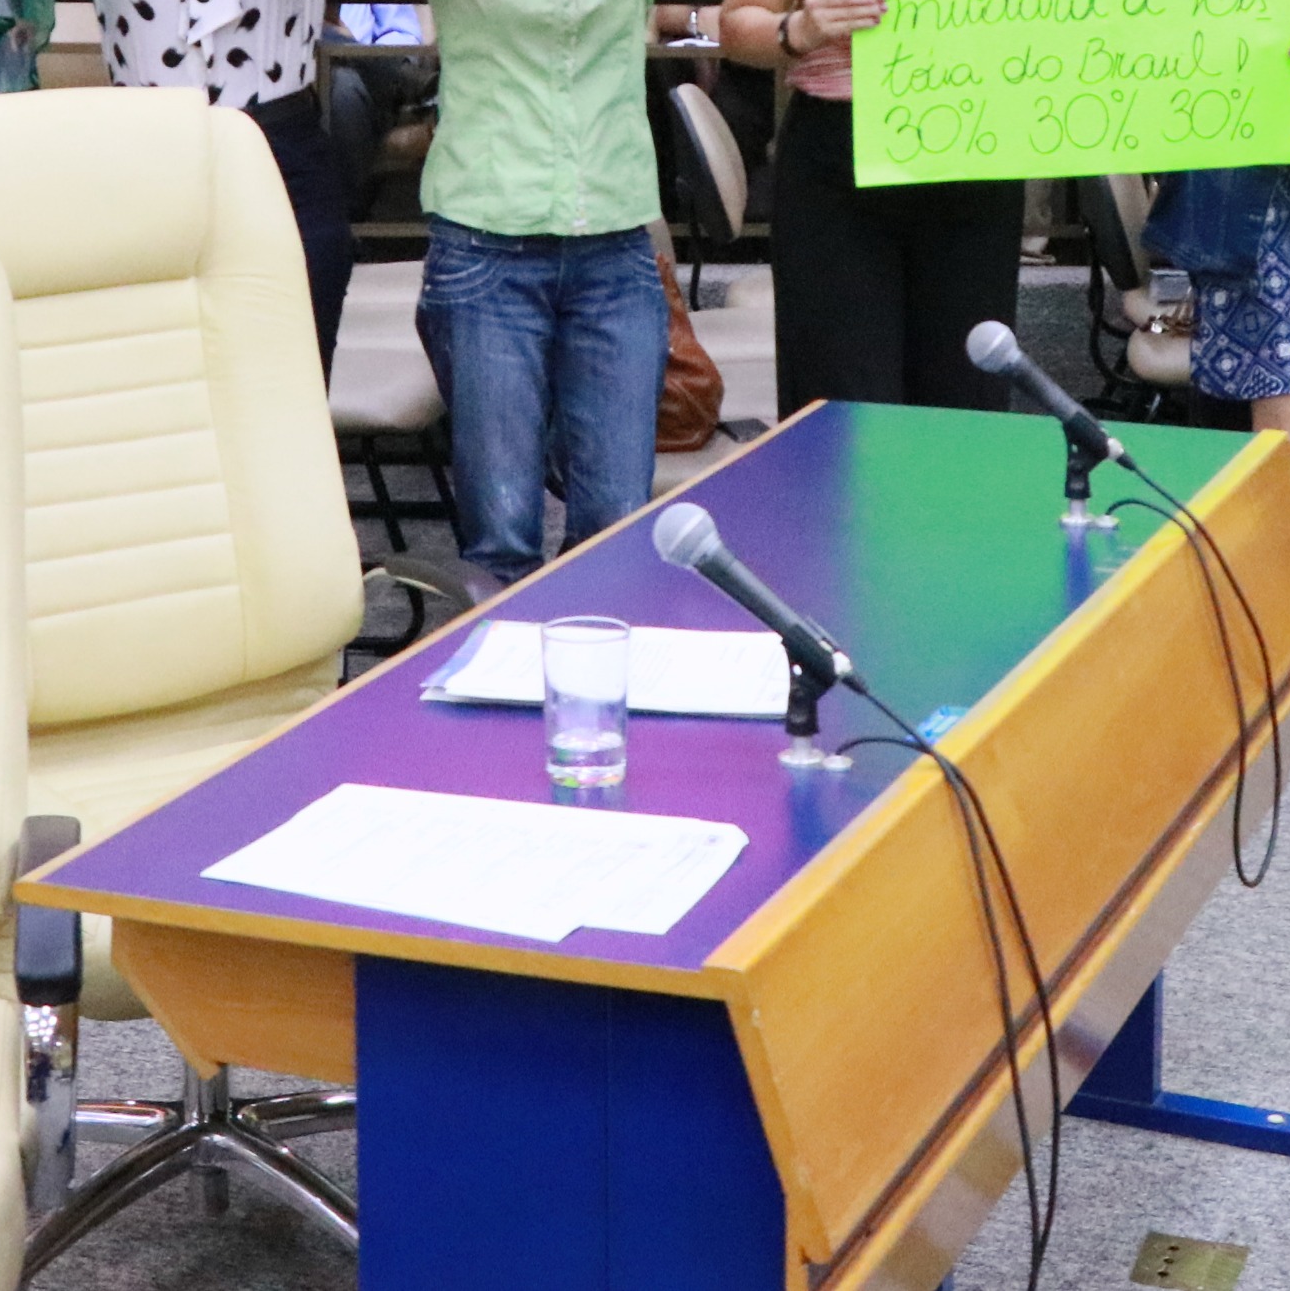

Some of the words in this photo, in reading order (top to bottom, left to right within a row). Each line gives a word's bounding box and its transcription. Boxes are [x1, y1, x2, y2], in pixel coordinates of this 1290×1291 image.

[1002, 44, 1064, 85] do
[883, 97, 998, 164] 30%
[1028, 87, 1140, 156] 30%
[1162, 85, 1255, 144] 30%
